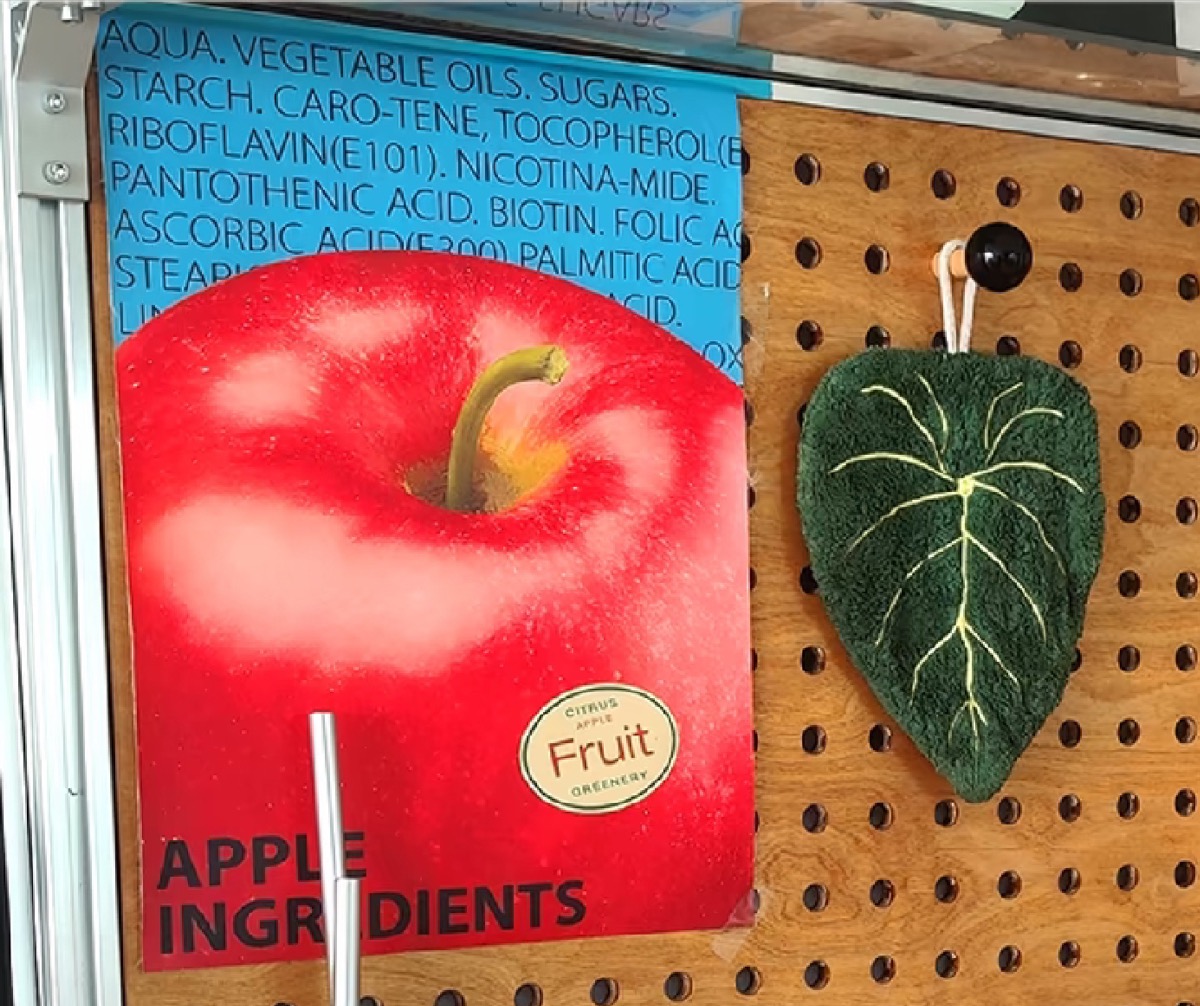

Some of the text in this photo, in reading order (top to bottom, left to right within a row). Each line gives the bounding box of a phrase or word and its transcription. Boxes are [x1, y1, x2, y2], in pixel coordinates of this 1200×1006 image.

[102, 19, 677, 117] AQUA. VEGETABLE OILS. SUGARS.
[104, 64, 263, 115] STARCH.
[274, 85, 488, 143] CARO-TENE,
[108, 113, 715, 206] RIBOFLAVIN(E101). NICOTINA-MIDE.
[111, 160, 375, 215] PANTOTHENIC
[387, 187, 478, 226] ACID.
[489, 196, 604, 236] BIOTIN.
[615, 208, 702, 246] FOLIC
[114, 208, 304, 254] ASCORBIC
[520, 242, 663, 284] PALMITIC
[672, 255, 741, 291] ACID
[115, 254, 682, 327] STEAR CID.
[565, 697, 618, 717] CITRUS
[576, 714, 612, 730] APPLE
[548, 723, 655, 778] Fruit
[571, 771, 648, 797] GREENERY
[157, 831, 366, 890] APPLE
[160, 879, 587, 954] INGRDIENTS
